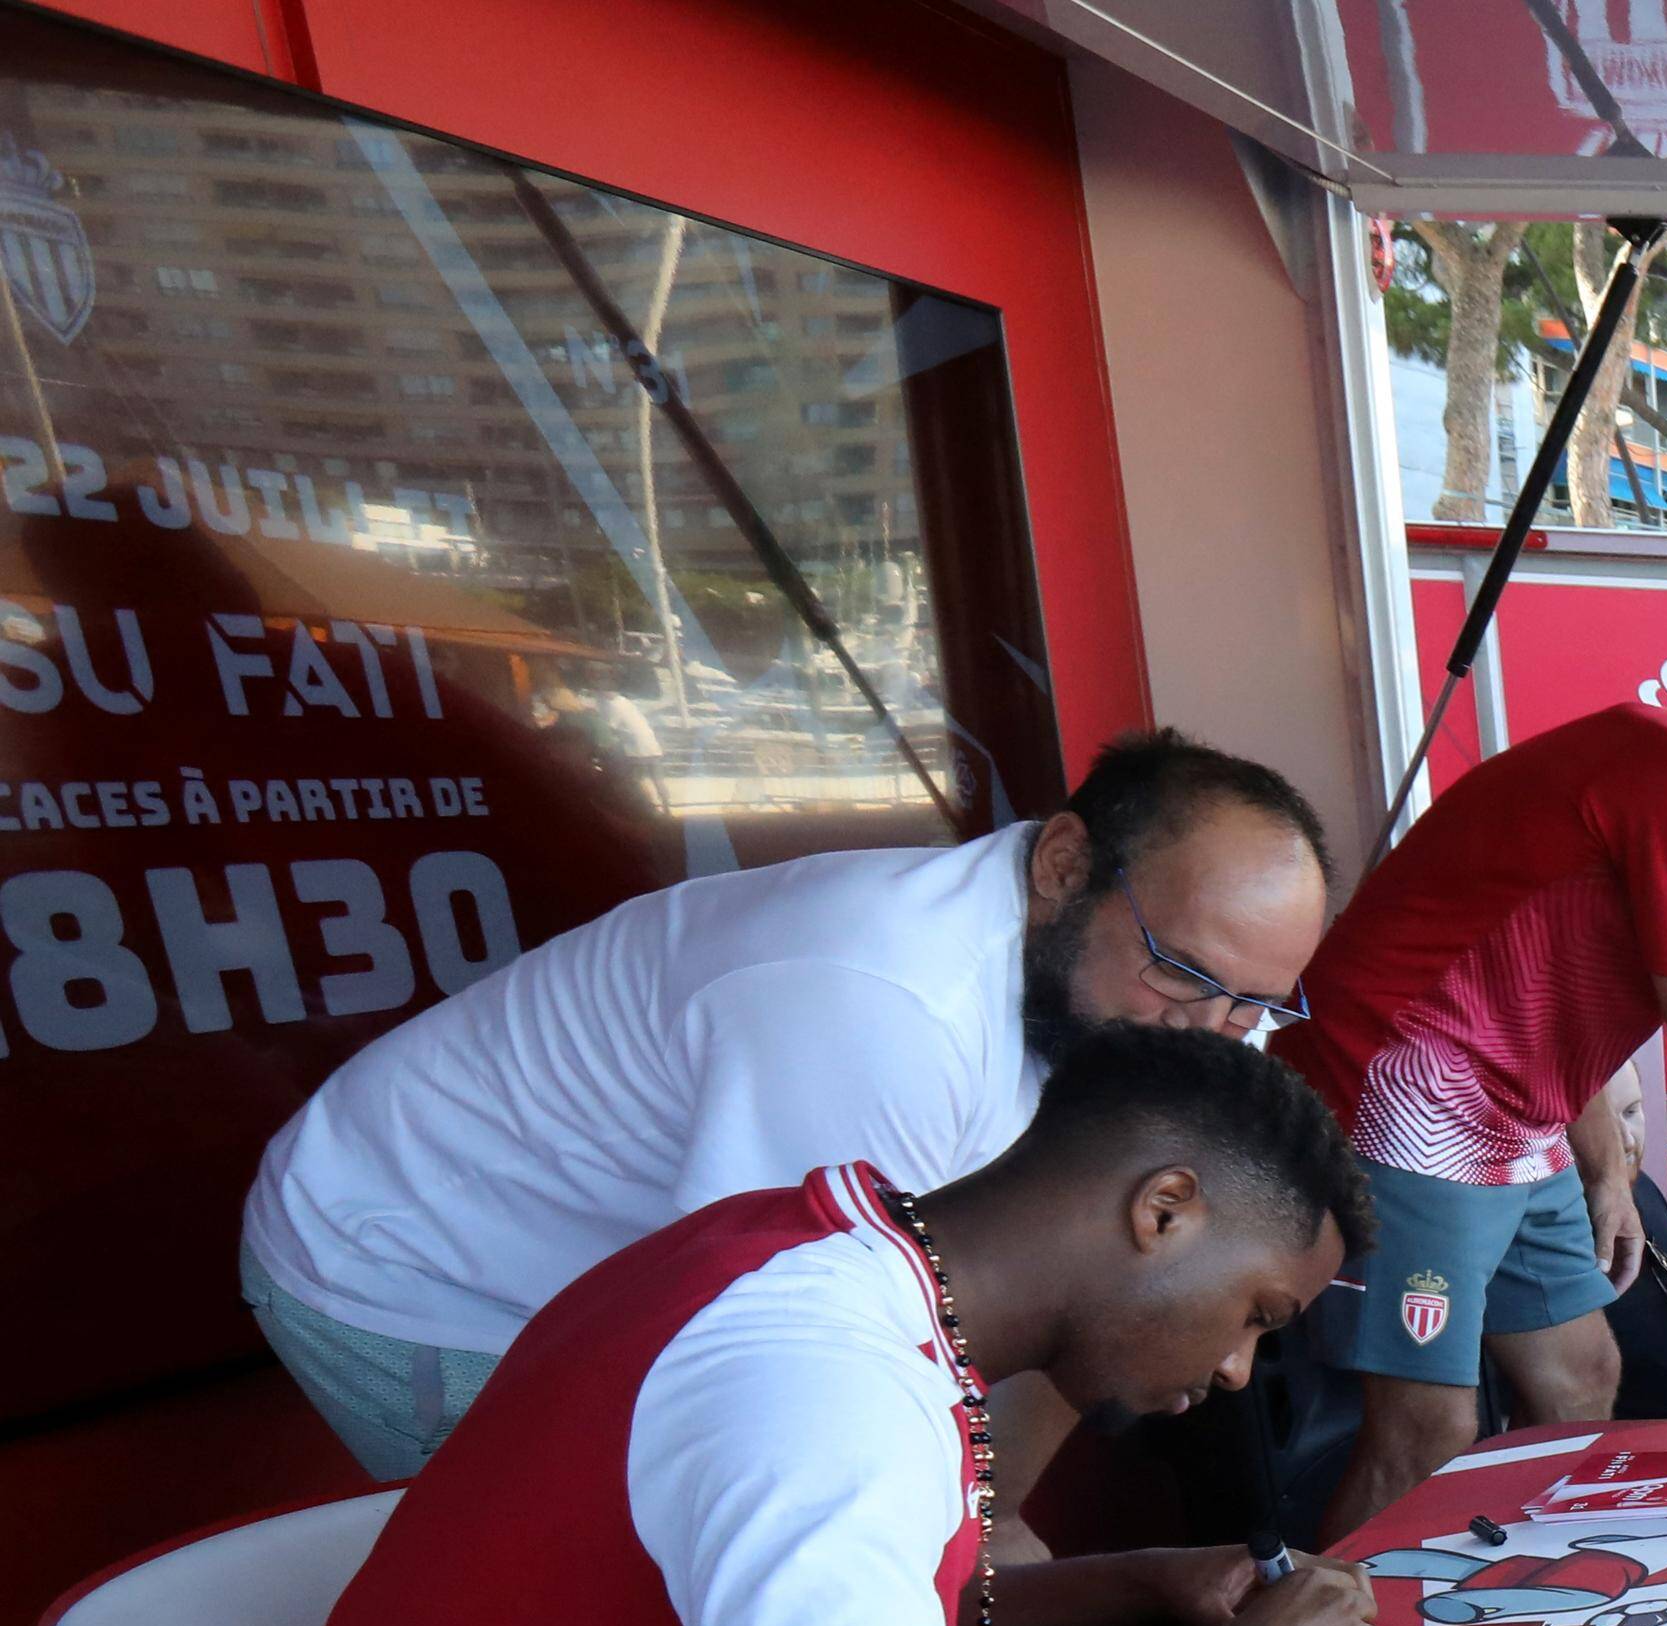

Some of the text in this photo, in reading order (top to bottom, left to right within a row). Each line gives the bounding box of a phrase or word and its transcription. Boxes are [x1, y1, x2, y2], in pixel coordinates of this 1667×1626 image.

[0, 434, 119, 523] 22
[207, 612, 443, 719] FATI
[180, 766, 222, 824] À
[229, 778, 423, 829] PARTIR
[431, 776, 490, 818] DE
[0, 849, 524, 1060] 8H30
